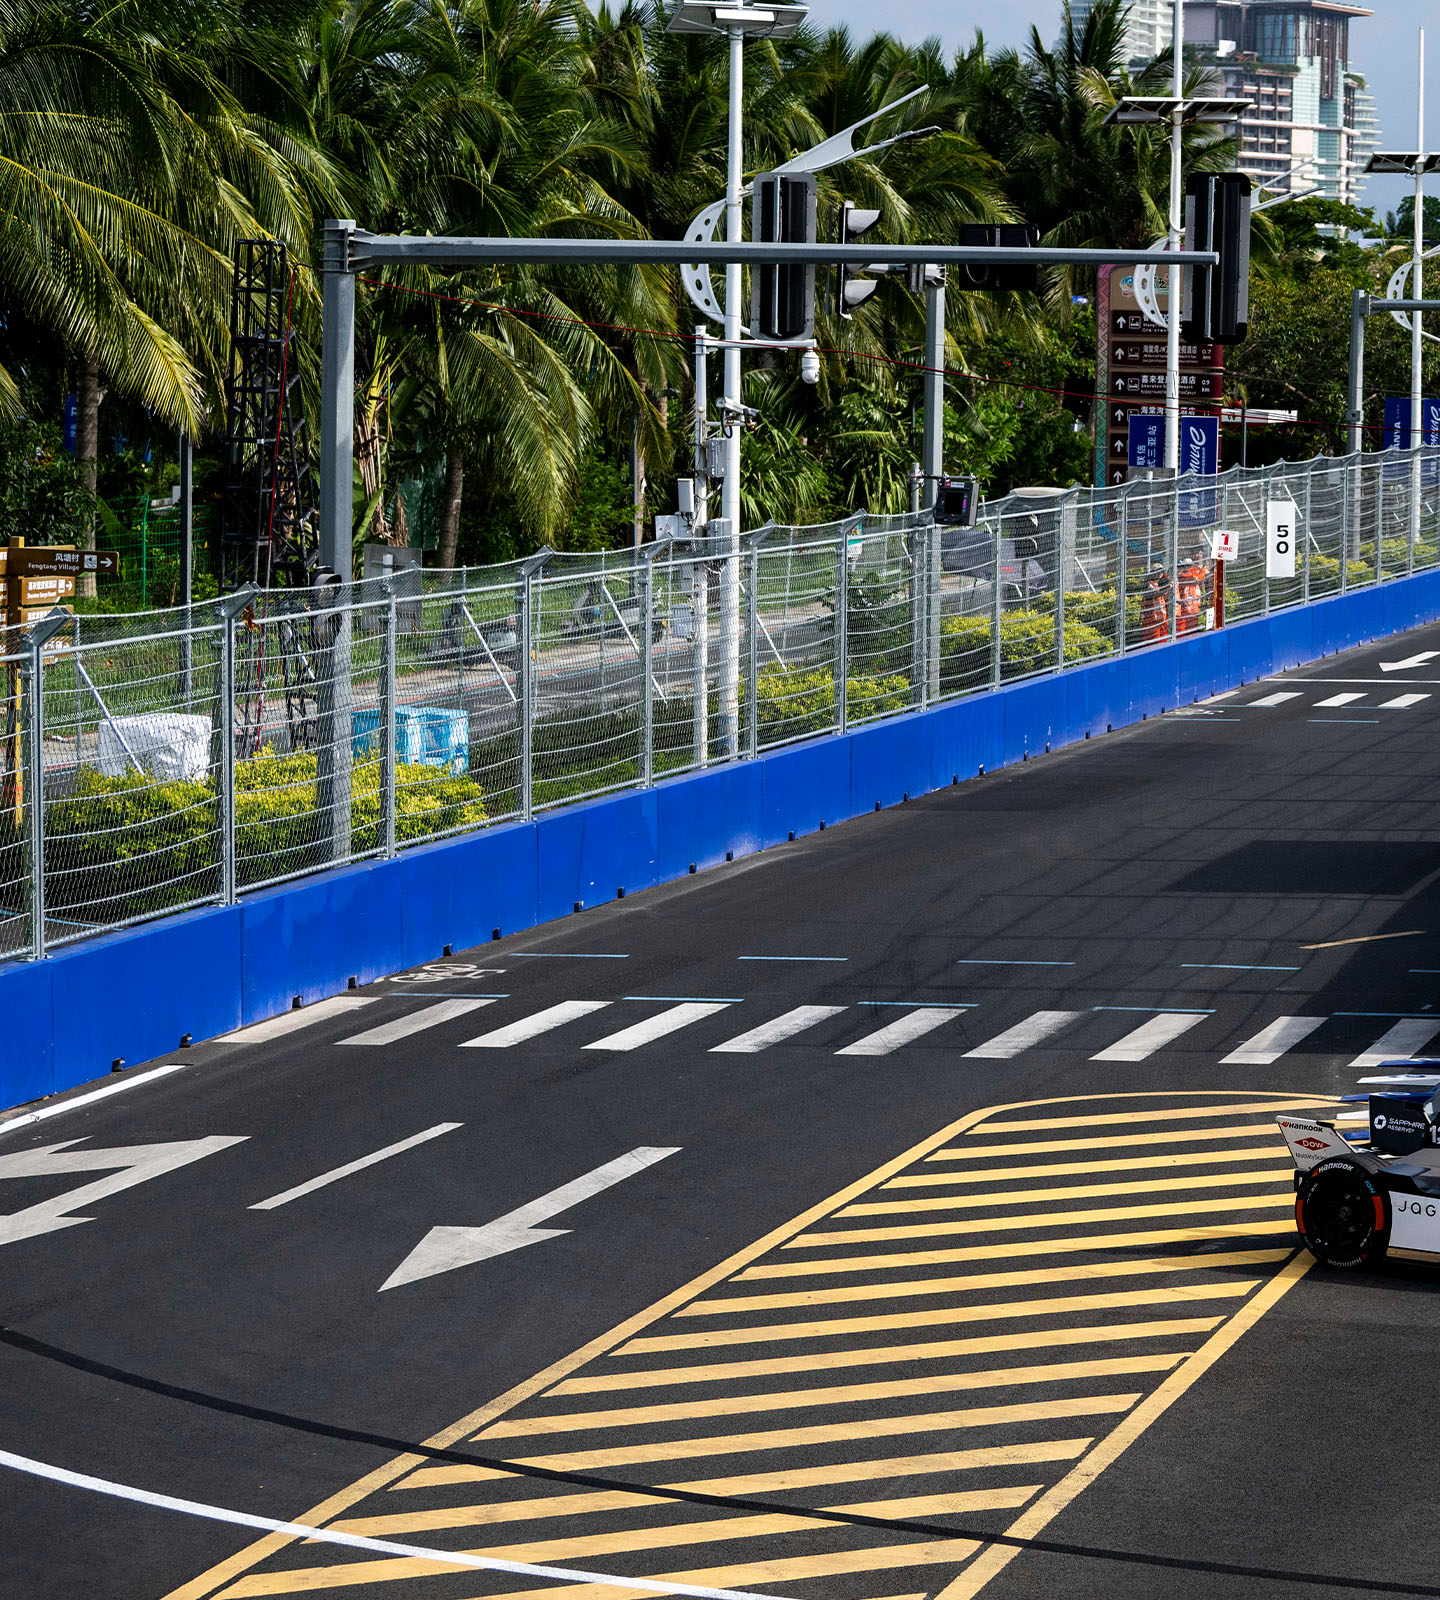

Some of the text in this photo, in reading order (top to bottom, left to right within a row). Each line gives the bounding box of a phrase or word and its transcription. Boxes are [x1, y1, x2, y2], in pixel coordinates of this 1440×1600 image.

[1141, 375, 1196, 385] 喜来登酒店
[1276, 524, 1289, 554] 50
[28, 563, 57, 571] Fengtang
[1388, 1117, 1426, 1130] SAPPHIRE
